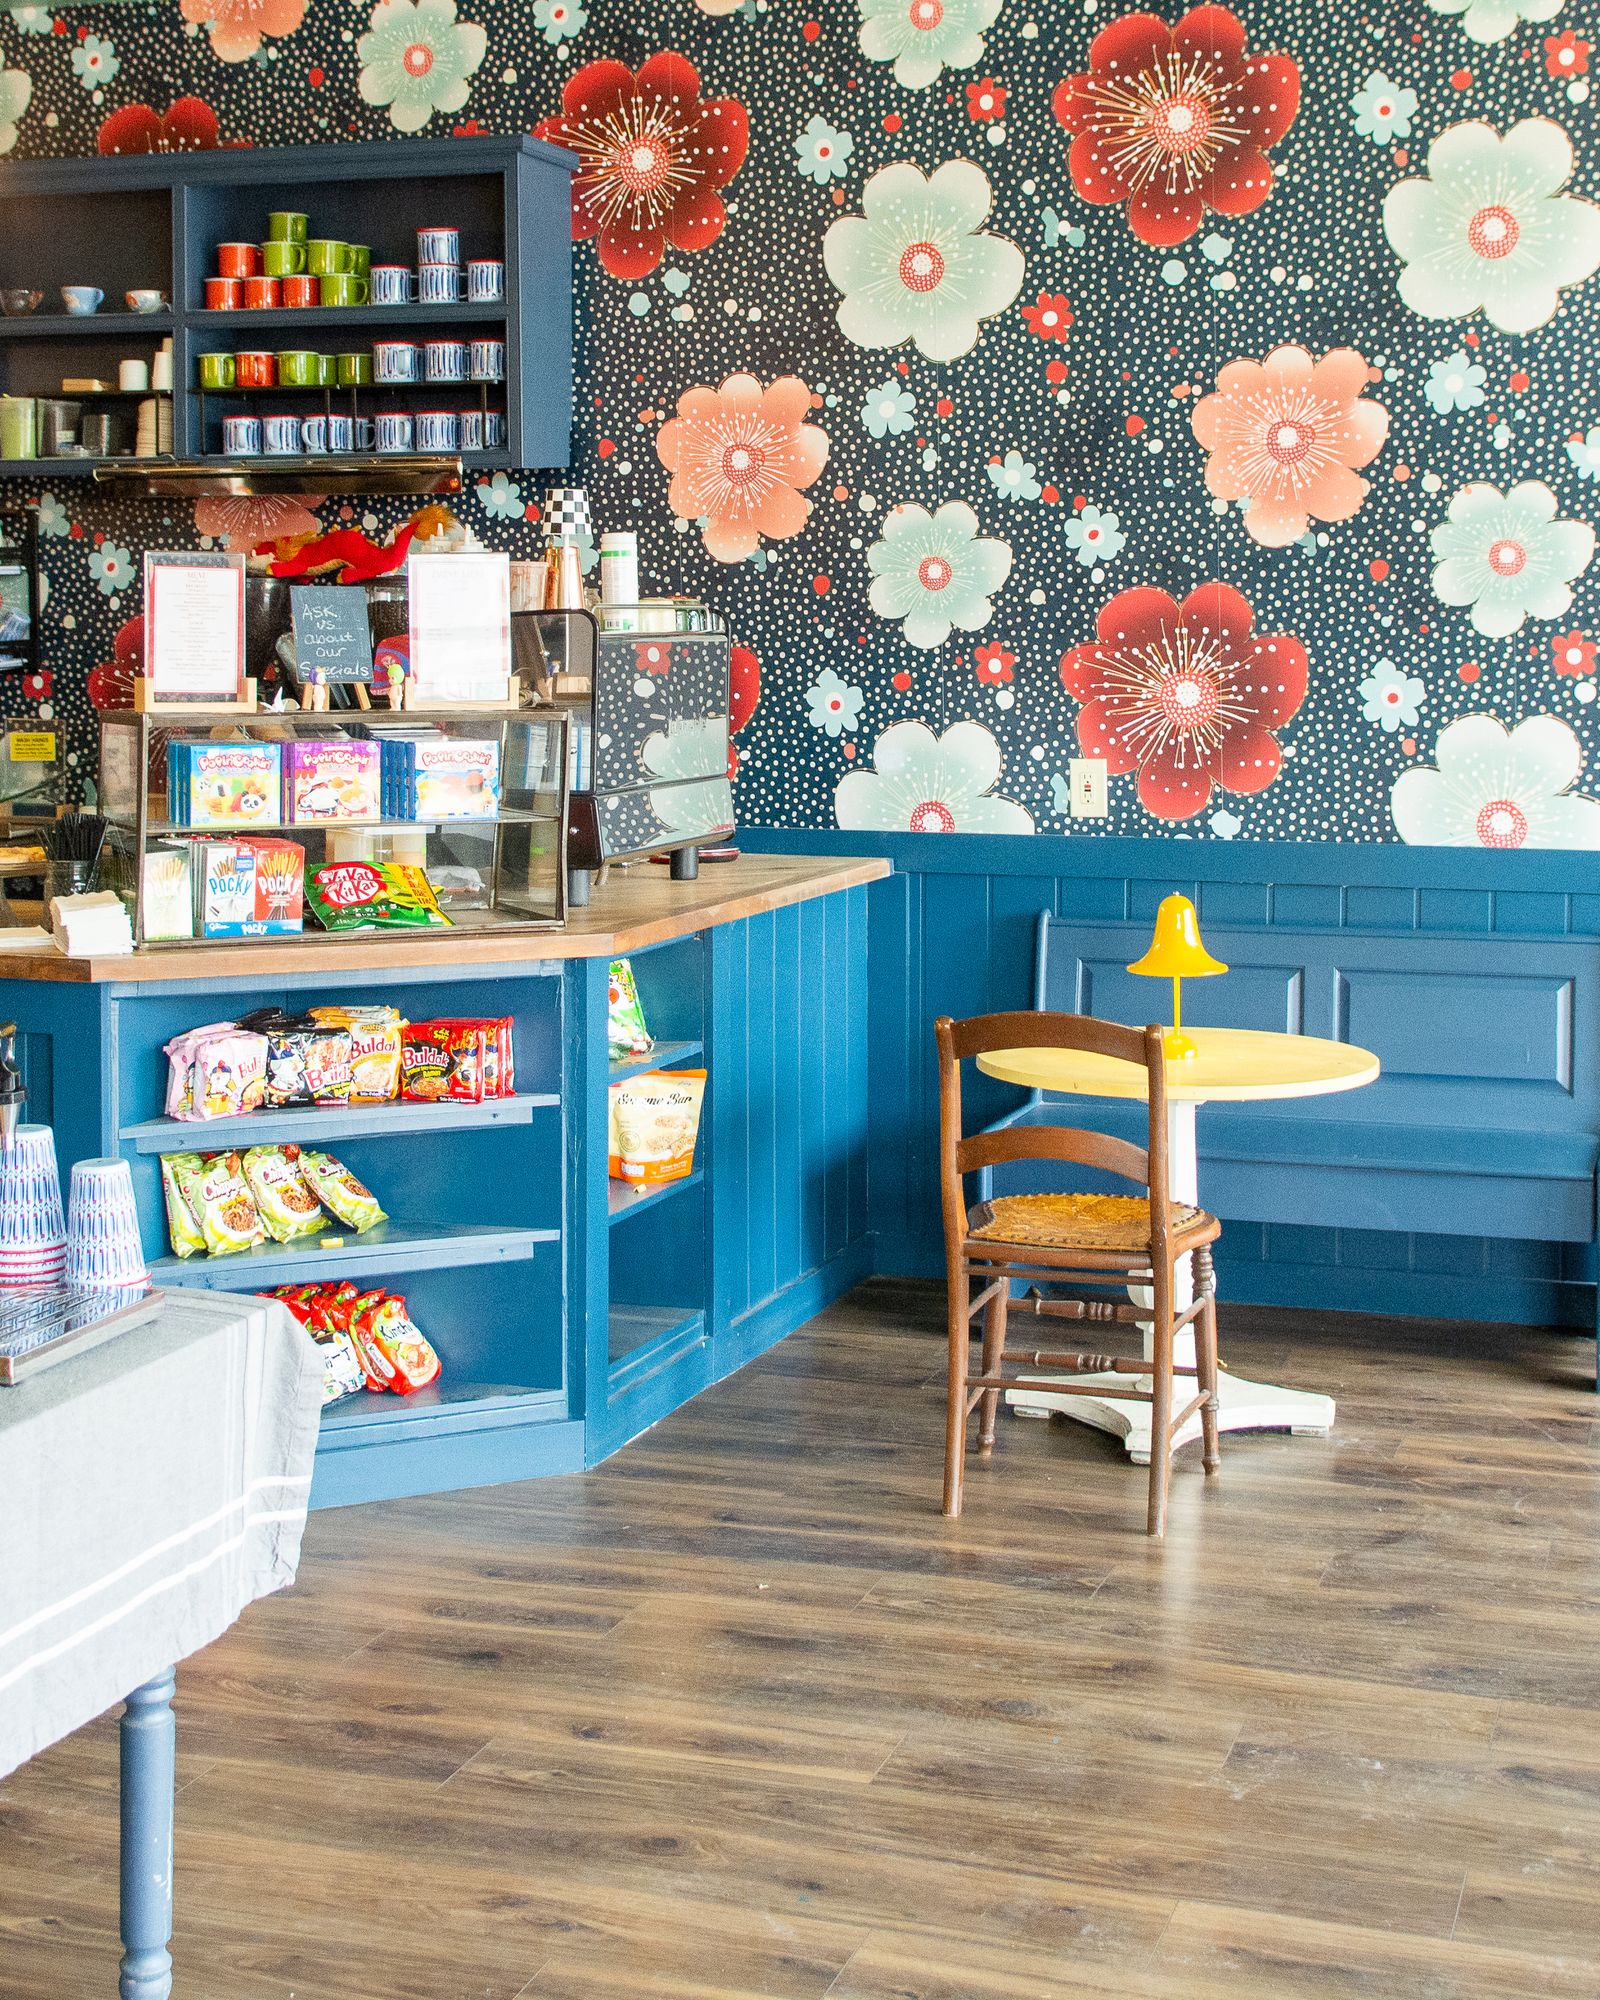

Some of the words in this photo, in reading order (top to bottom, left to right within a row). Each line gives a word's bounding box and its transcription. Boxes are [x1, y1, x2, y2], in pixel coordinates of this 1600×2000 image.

[303, 603, 338, 620] ASK
[304, 632, 353, 644] about
[316, 647, 347, 657] our
[300, 660, 369, 678] Secials
[333, 880, 377, 902] KitKat
[402, 1047, 449, 1069] Buldak
[617, 1092, 664, 1106] Seme
[667, 1092, 692, 1106] Bar
